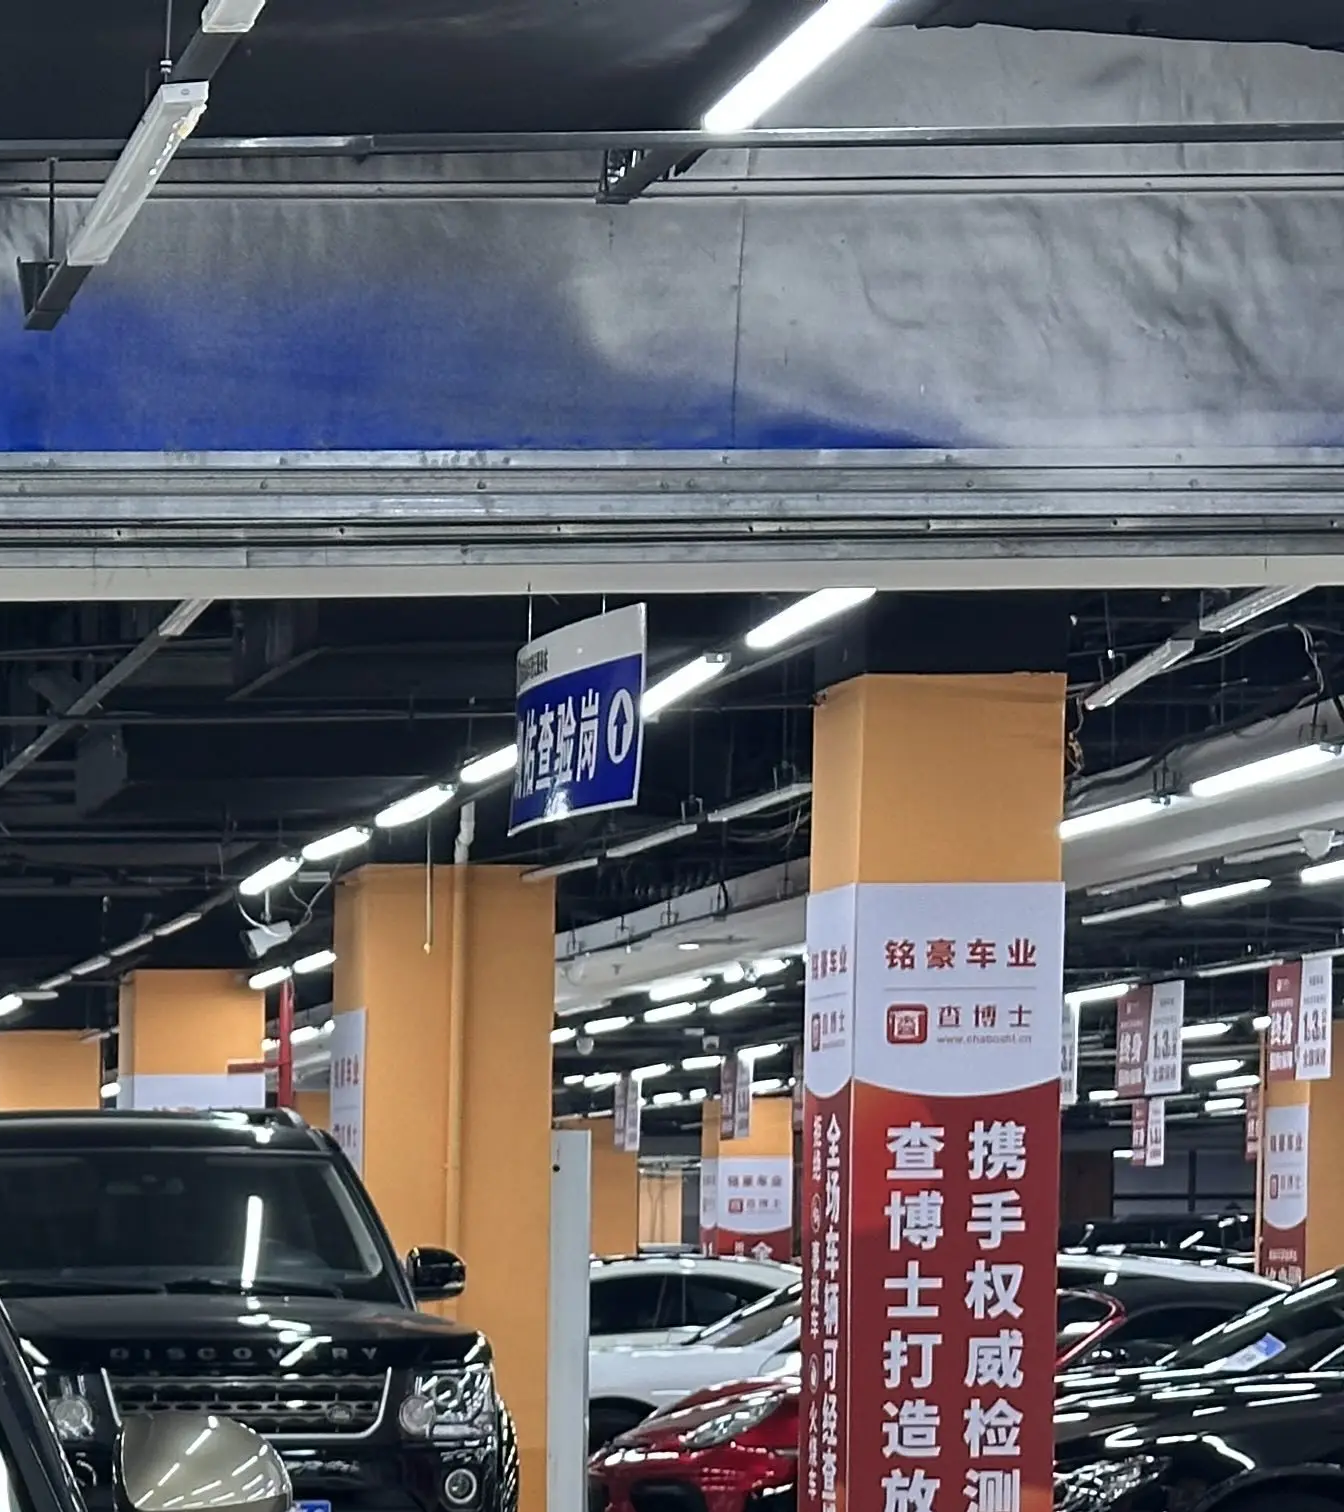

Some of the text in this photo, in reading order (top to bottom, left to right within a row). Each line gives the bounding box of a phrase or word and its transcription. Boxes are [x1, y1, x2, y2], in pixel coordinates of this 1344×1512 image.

[885, 938, 1037, 970] 铭豪车业
[937, 1004, 1032, 1029] 查博士
